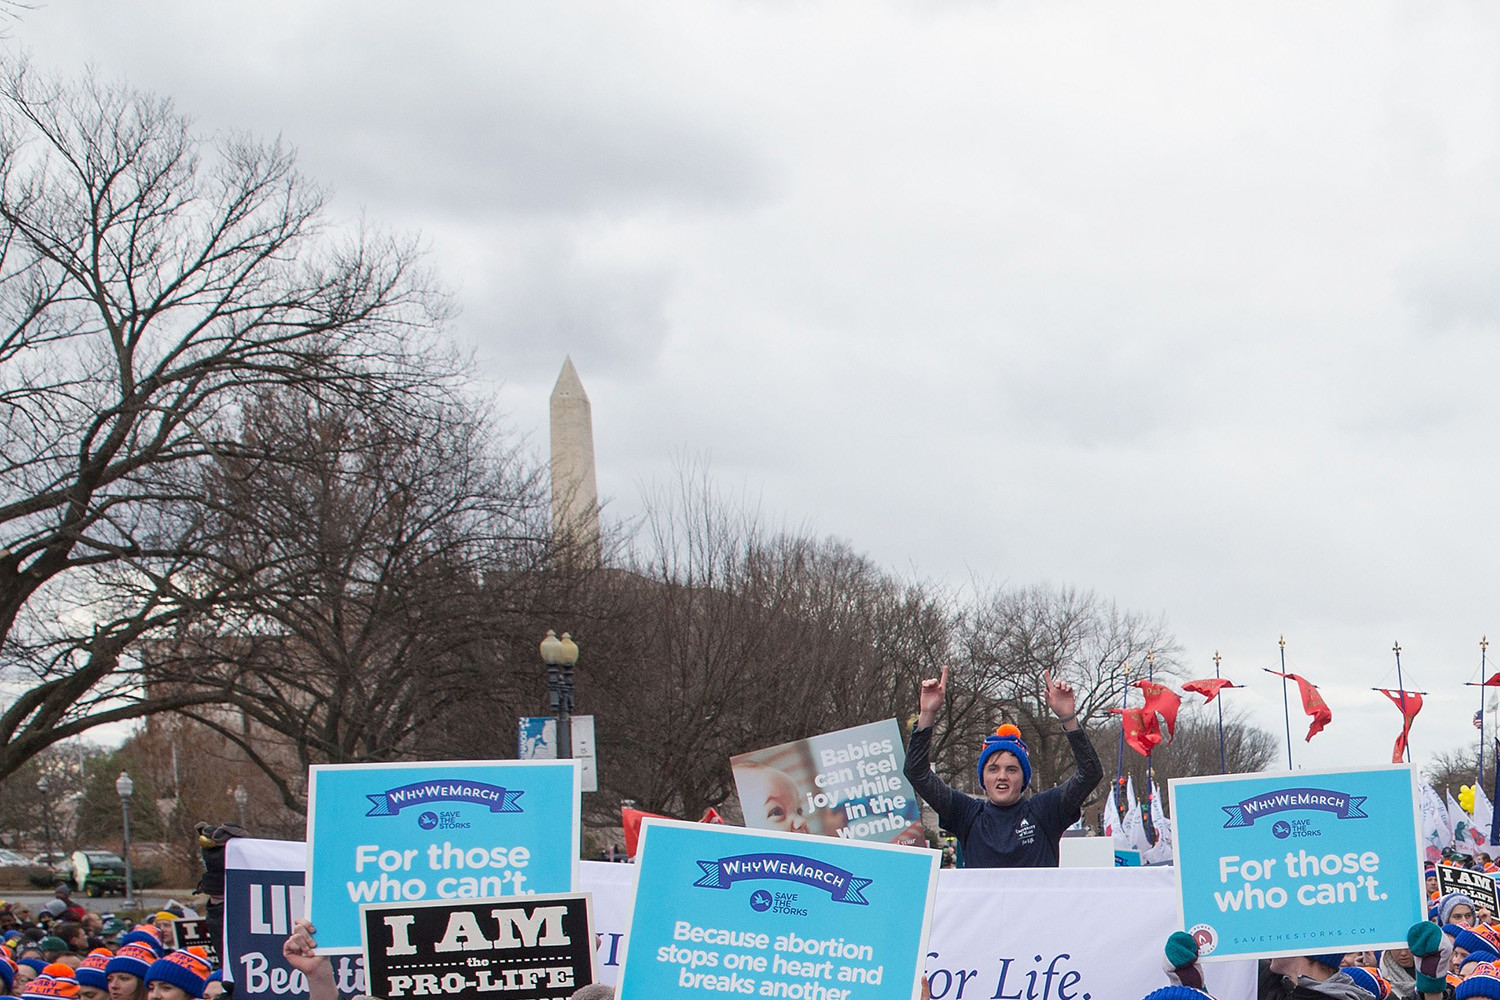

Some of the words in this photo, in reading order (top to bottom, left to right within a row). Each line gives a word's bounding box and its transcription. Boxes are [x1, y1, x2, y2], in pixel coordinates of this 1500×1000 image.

[820, 739, 893, 767] Babies
[814, 767, 854, 788] can
[856, 753, 897, 779] feel
[806, 791, 839, 813] joy
[844, 776, 902, 800] while
[845, 803, 867, 820] in
[869, 795, 906, 814] the
[439, 822, 471, 830] STORKS
[836, 813, 911, 839] womb.
[1292, 829, 1321, 838] STORKS
[355, 845, 418, 873] For
[428, 841, 531, 871] those
[1219, 855, 1276, 883] For
[1284, 849, 1379, 878] those
[346, 873, 426, 903] who
[1443, 868, 1453, 882] I
[1458, 871, 1492, 891] AM
[774, 899, 791, 908] THE
[775, 892, 797, 902] SAVE
[1214, 883, 1287, 912] who
[772, 905, 808, 917] STORKS
[383, 915, 417, 956] I
[434, 905, 571, 952] AM
[673, 921, 769, 950] Because
[773, 932, 873, 961] abortion
[1233, 927, 1377, 944] SAVETHESTORKS.COM
[466, 957, 489, 967] the
[657, 944, 718, 968] stops
[724, 953, 767, 972] one
[772, 954, 833, 978] heart
[837, 965, 882, 985] and
[387, 966, 575, 997] PRO-LIFE
[679, 968, 755, 995] breaks
